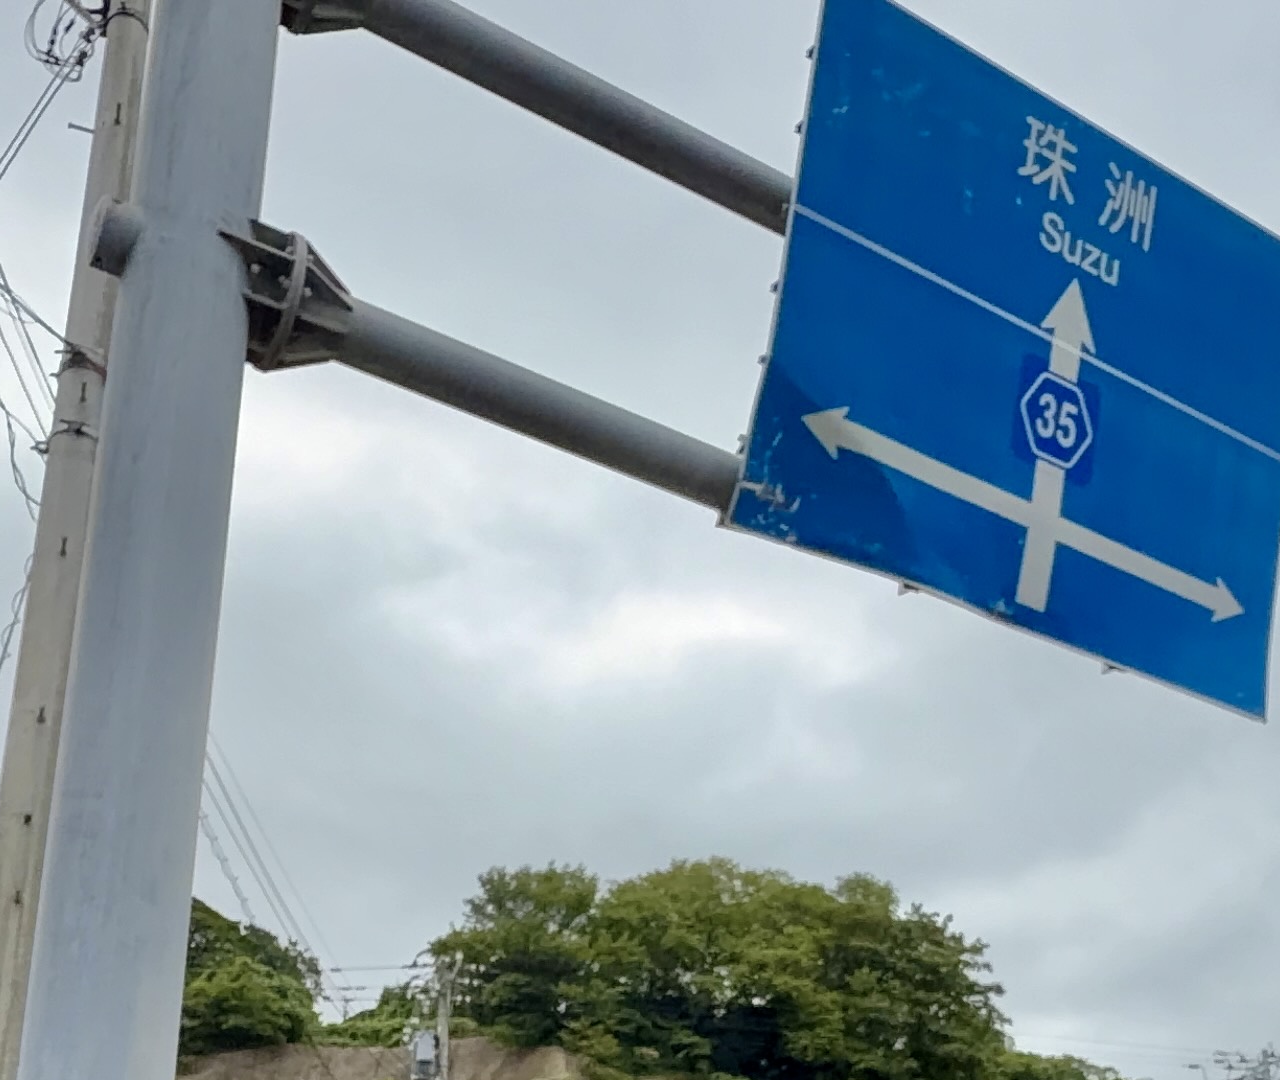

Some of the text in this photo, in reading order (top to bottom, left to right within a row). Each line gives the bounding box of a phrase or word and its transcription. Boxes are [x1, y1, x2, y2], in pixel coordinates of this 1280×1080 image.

[1017, 115, 1158, 253] 珠洲
[1039, 211, 1120, 287] Suzu
[1035, 392, 1079, 449] 35
